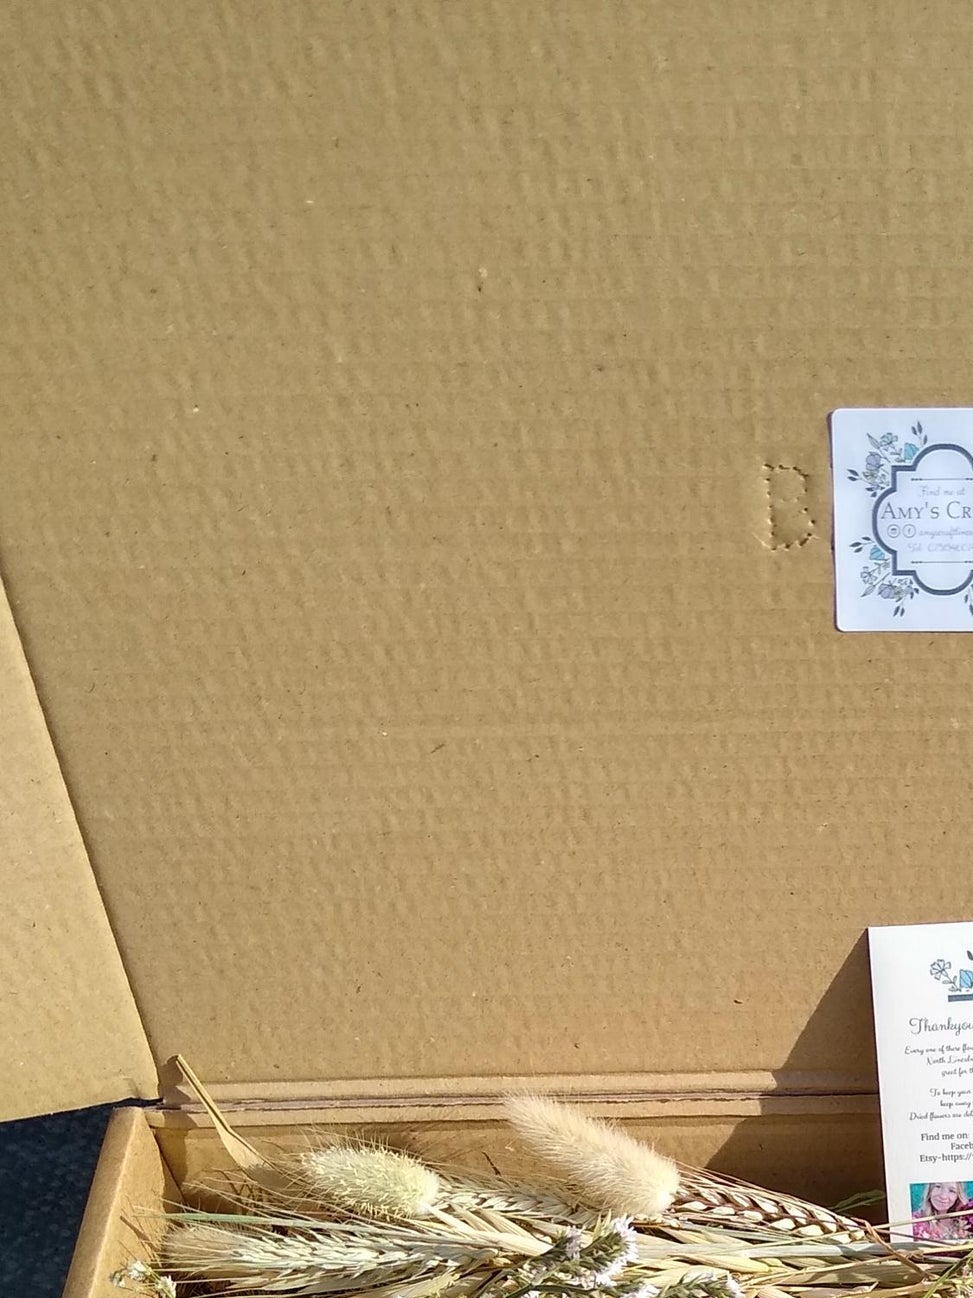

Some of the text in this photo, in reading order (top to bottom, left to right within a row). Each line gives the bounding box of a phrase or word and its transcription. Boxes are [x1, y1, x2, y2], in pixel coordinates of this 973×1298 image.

[904, 1045, 924, 1056] Every
[938, 1044, 945, 1055] of
[927, 1056, 946, 1066] North
[941, 1069, 957, 1078] great
[958, 1066, 968, 1078] for
[929, 1087, 940, 1097] To
[942, 1087, 956, 1098] keep
[957, 1089, 970, 1098] your
[940, 1099, 953, 1110] keep
[954, 1101, 971, 1109] away
[909, 1111, 928, 1121] Dried
[929, 1111, 951, 1122] flowers
[920, 1133, 940, 1142] Find
